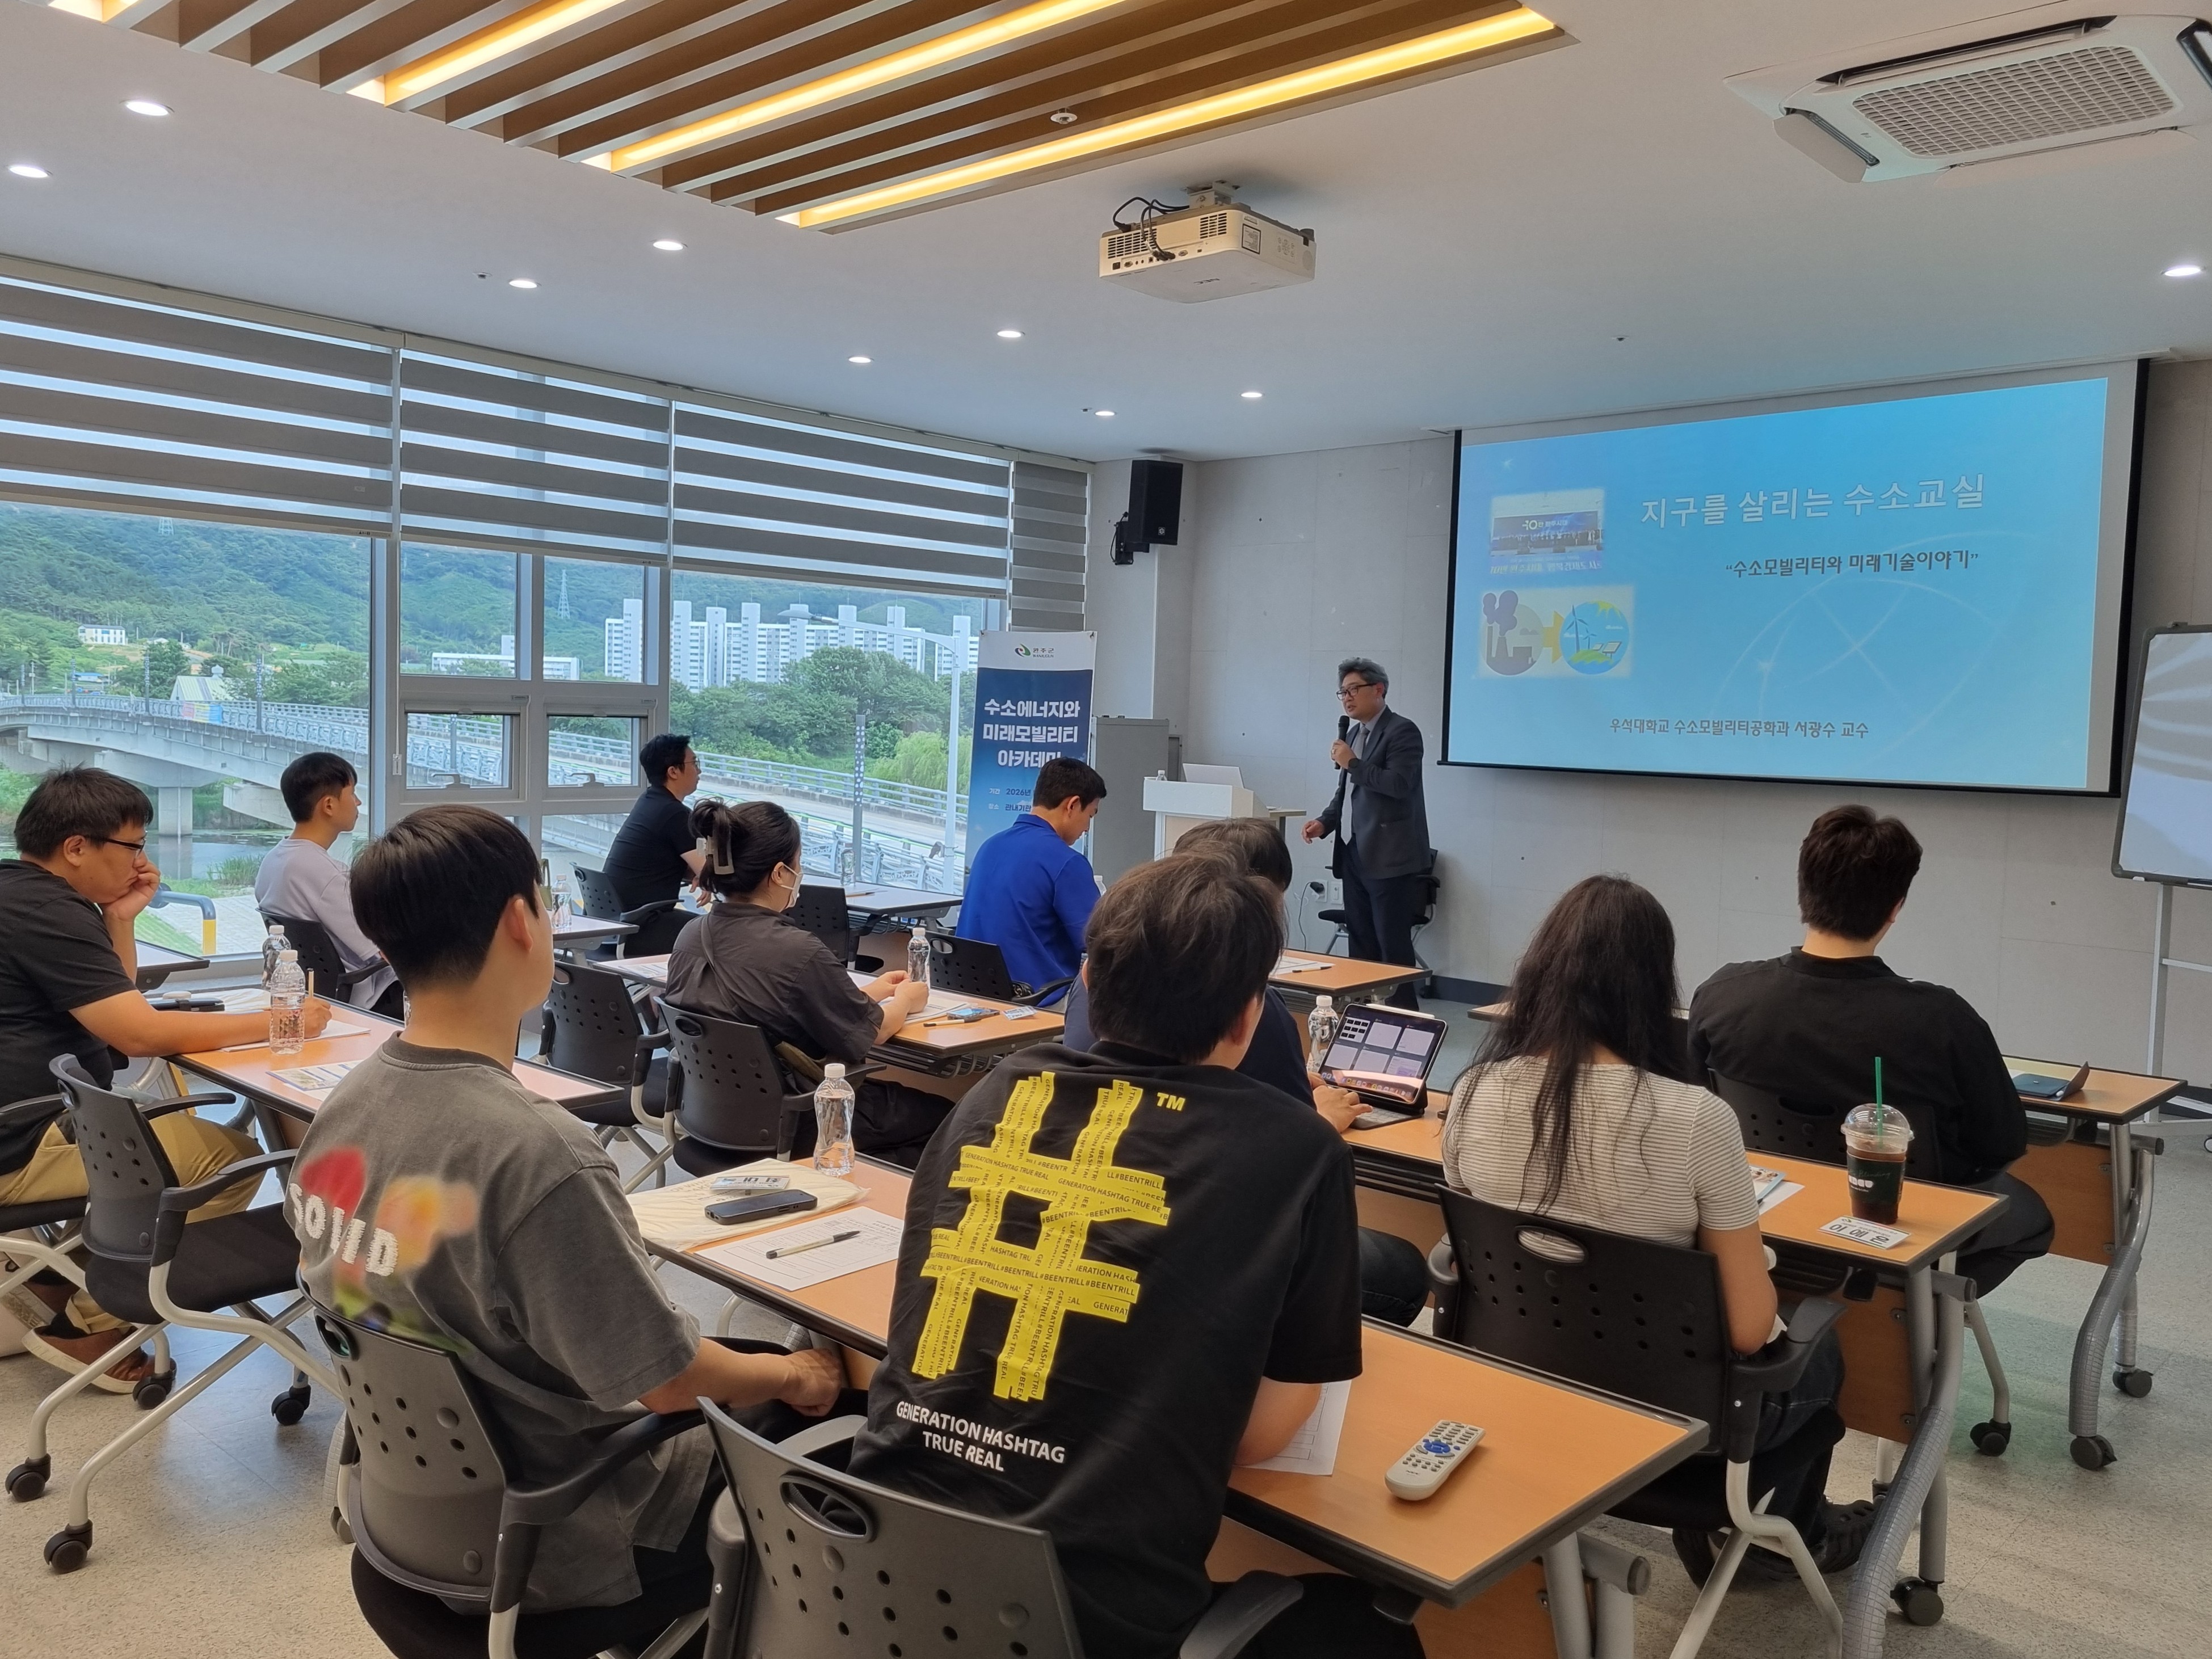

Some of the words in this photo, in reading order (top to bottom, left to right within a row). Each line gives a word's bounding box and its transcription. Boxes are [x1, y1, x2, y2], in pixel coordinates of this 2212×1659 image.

[1641, 494, 1730, 529] 지구를
[1738, 489, 1833, 522] 살리는
[1842, 473, 1987, 516] 수소교실
[984, 698, 1080, 718] 수소에너지와
[982, 724, 1078, 743] 미래모빌리티
[1609, 717, 1670, 735] 우석대학교
[1674, 718, 1790, 737] 수소모빌리티공학과
[1793, 721, 1837, 739] 서광수
[1841, 722, 1869, 739] 교수
[1005, 803, 1032, 812] 관내기관
[1157, 1092, 1186, 1111] TM
[965, 1152, 994, 1165] GENERATION
[993, 1160, 1019, 1172] HASHTAG
[1019, 1167, 1034, 1176] TRUE
[1034, 1172, 1050, 1181] REAL
[1071, 1131, 1091, 1175] GENERATION
[1058, 1177, 1097, 1193] GENERATION
[1096, 1188, 1130, 1203] HASHTAG
[1131, 1197, 1151, 1210] TRUE
[990, 1245, 1019, 1259] HASHTAG
[964, 1257, 1000, 1271] #BEENTRILL
[1000, 1266, 1039, 1279] #BEENTRILL
[1039, 1273, 1085, 1286] #BEENTRILL
[1085, 1281, 1136, 1296] #BEENTRILL
[1011, 1302, 1028, 1341] HASHTAG
[1000, 1360, 1008, 1380] REAL
[1033, 1341, 1050, 1378] HASHTAG
[896, 1400, 982, 1441] GENERATION
[982, 1426, 1066, 1464] HASHTAG
[922, 1431, 965, 1458] TRUE
[965, 1445, 1005, 1472] REAL
